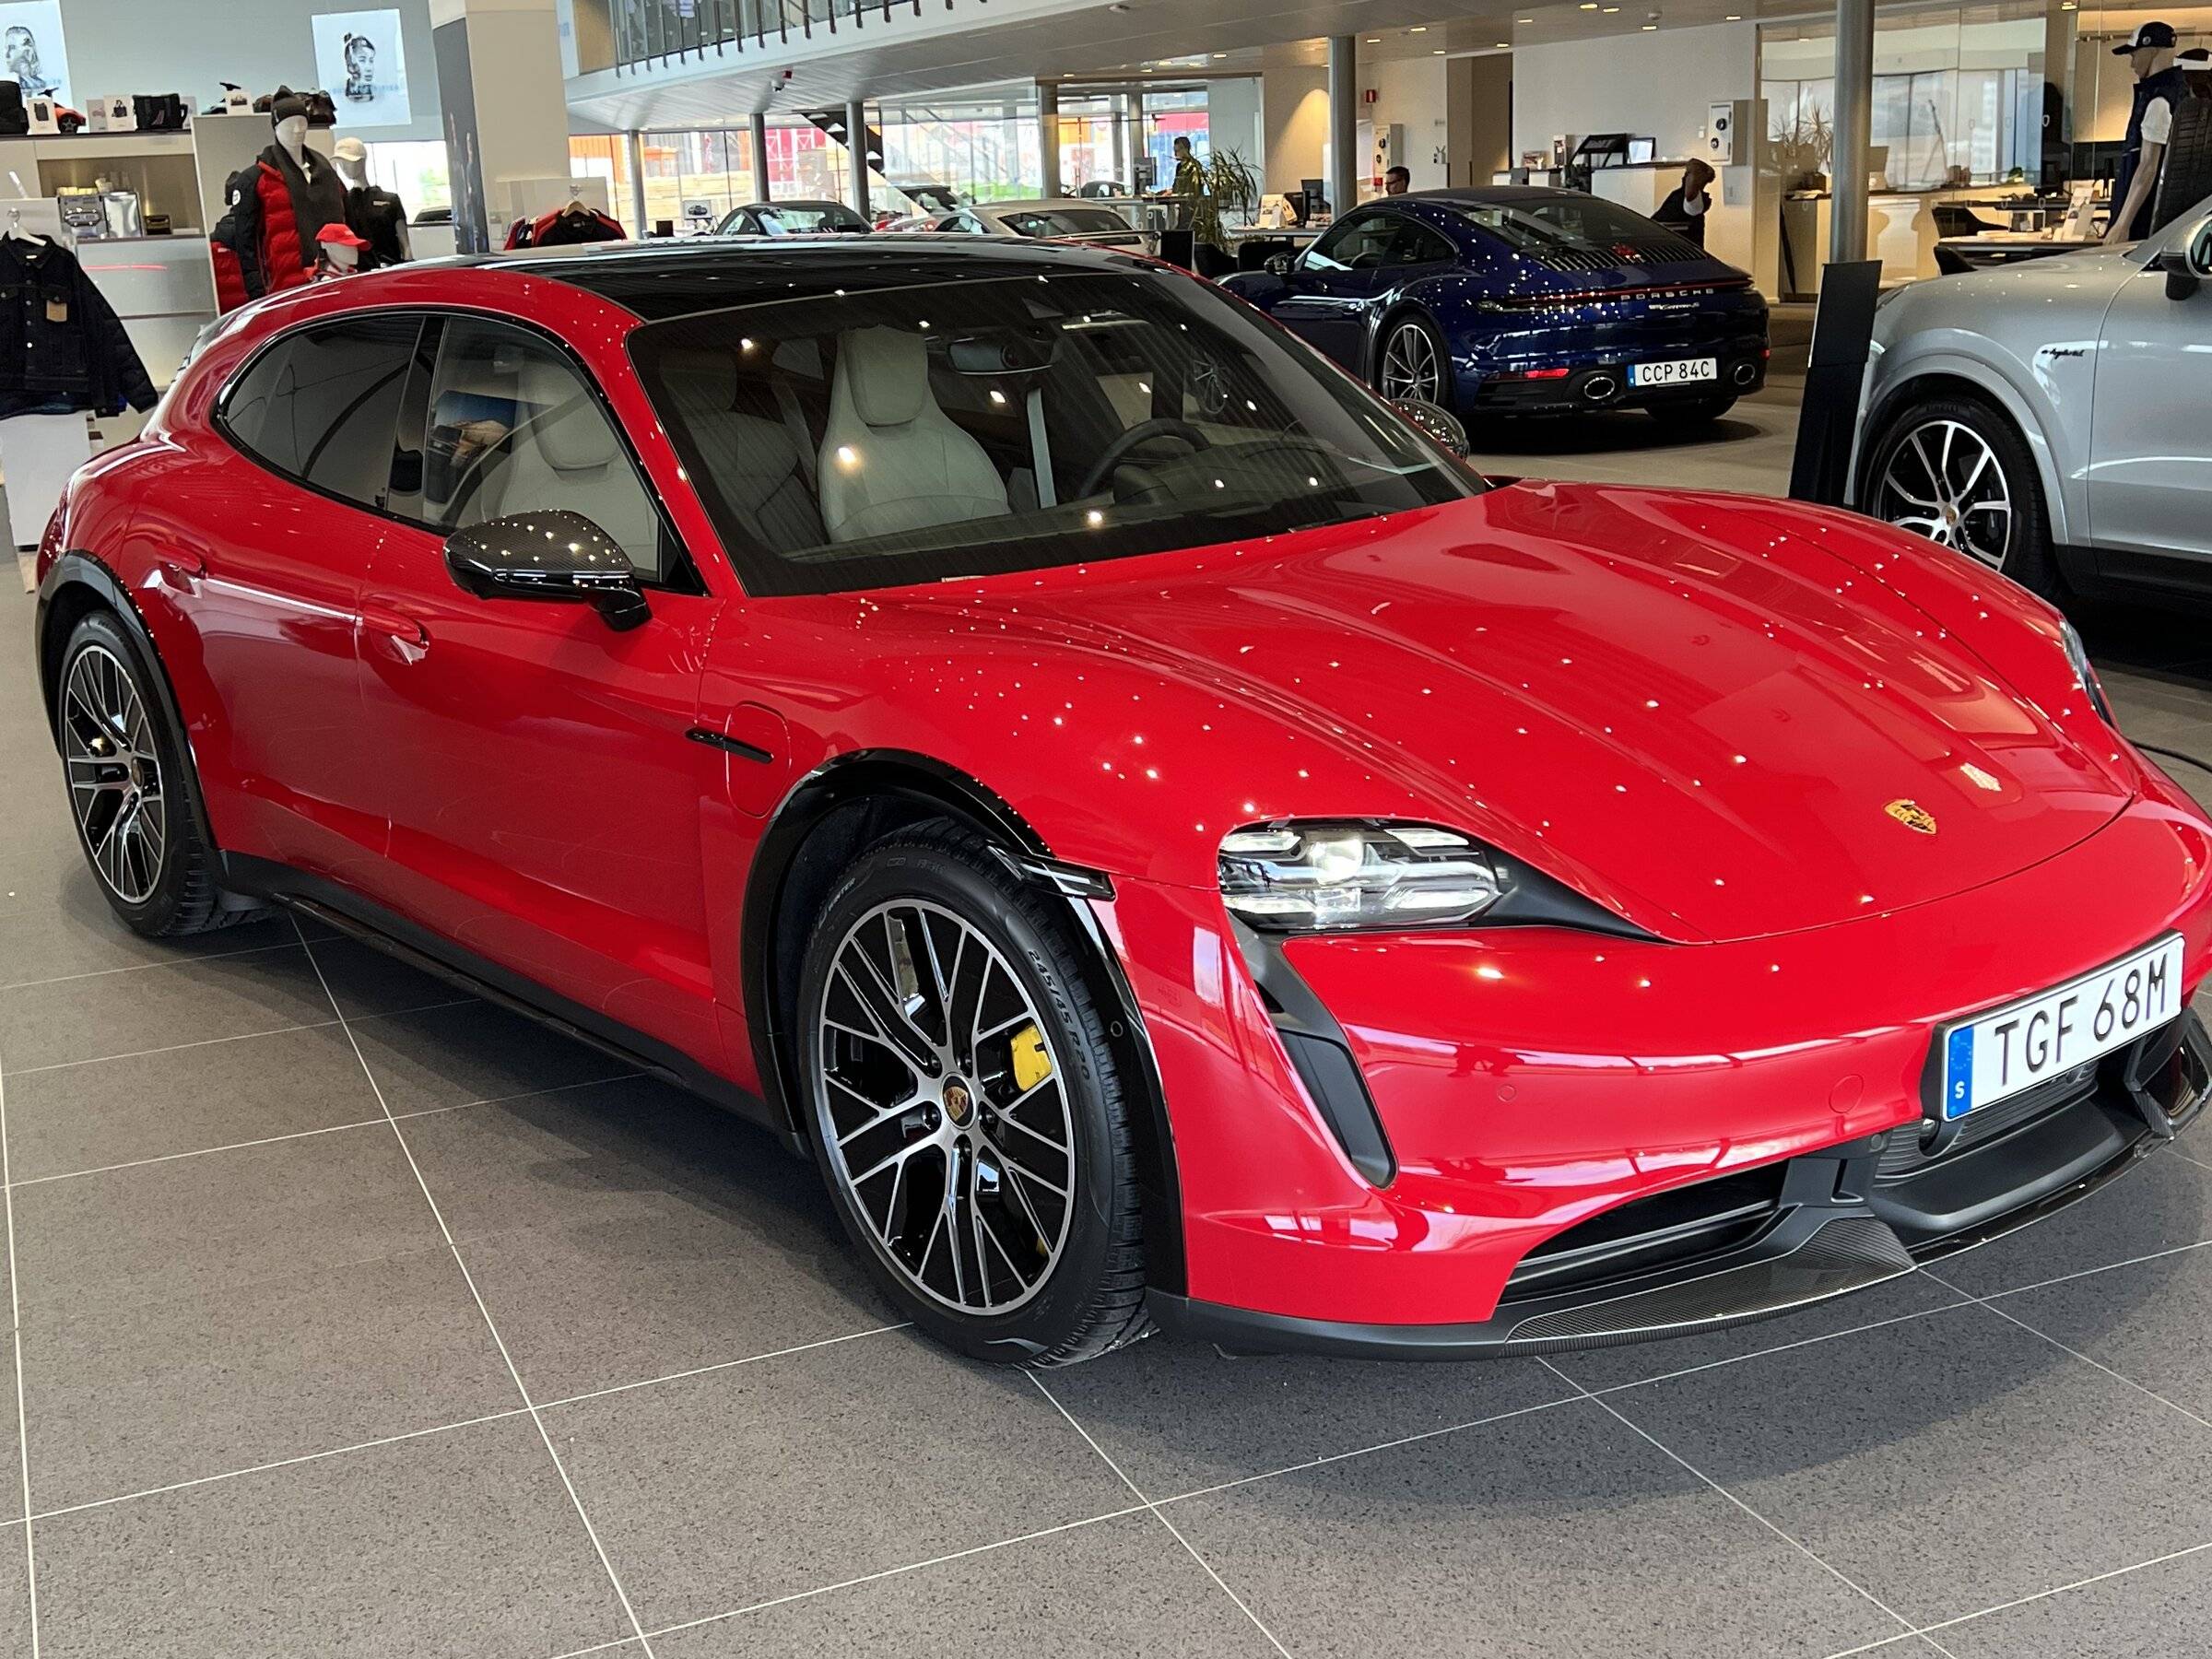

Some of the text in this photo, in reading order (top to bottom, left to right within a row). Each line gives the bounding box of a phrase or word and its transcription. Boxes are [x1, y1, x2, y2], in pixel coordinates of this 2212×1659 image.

[1620, 288, 1713, 300] PORSCHE
[1642, 361, 1710, 382] CCP 84C
[1028, 949, 1073, 1025] 245/45
[1994, 952, 2168, 1087] TGF 68M
[1954, 1080, 1965, 1100] S
